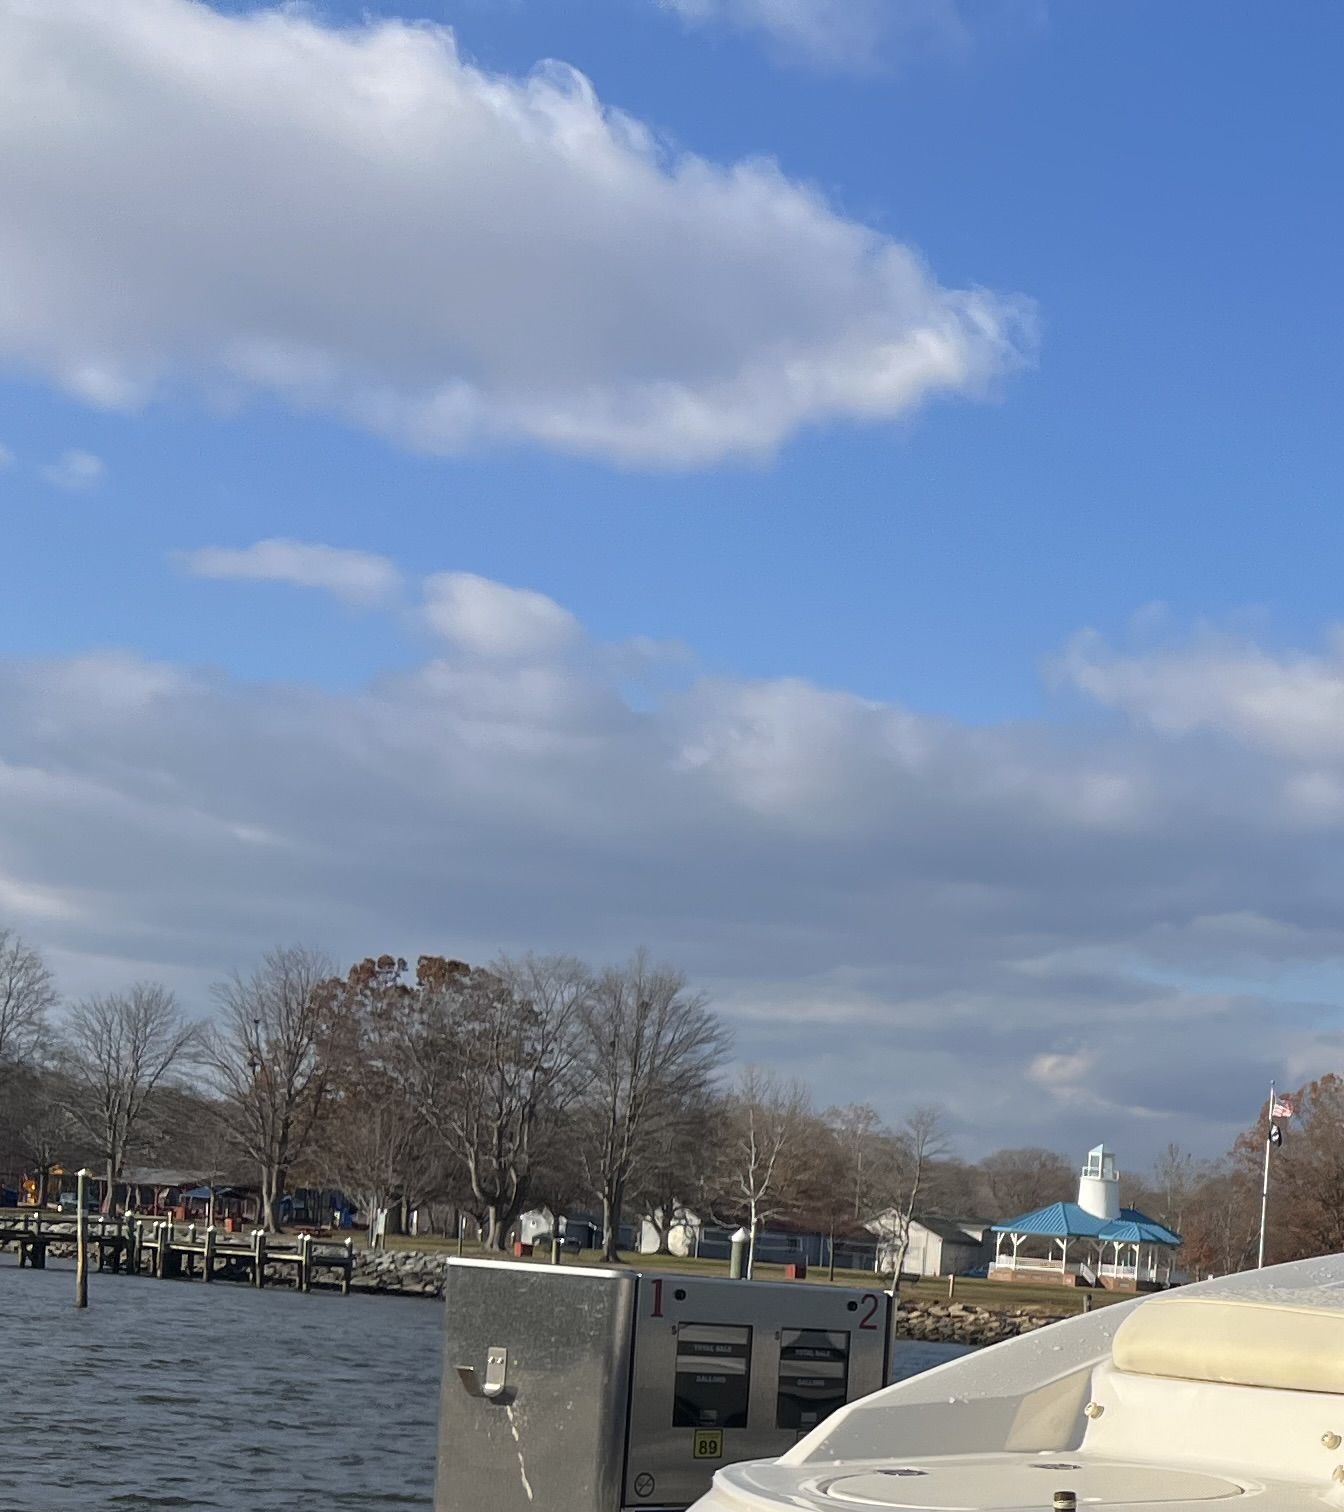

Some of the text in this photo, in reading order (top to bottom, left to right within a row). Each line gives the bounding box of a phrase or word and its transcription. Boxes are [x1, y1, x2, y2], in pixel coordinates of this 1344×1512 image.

[650, 1279, 664, 1318] 1
[859, 1294, 878, 1330] 2
[699, 1440, 718, 1455] 89
